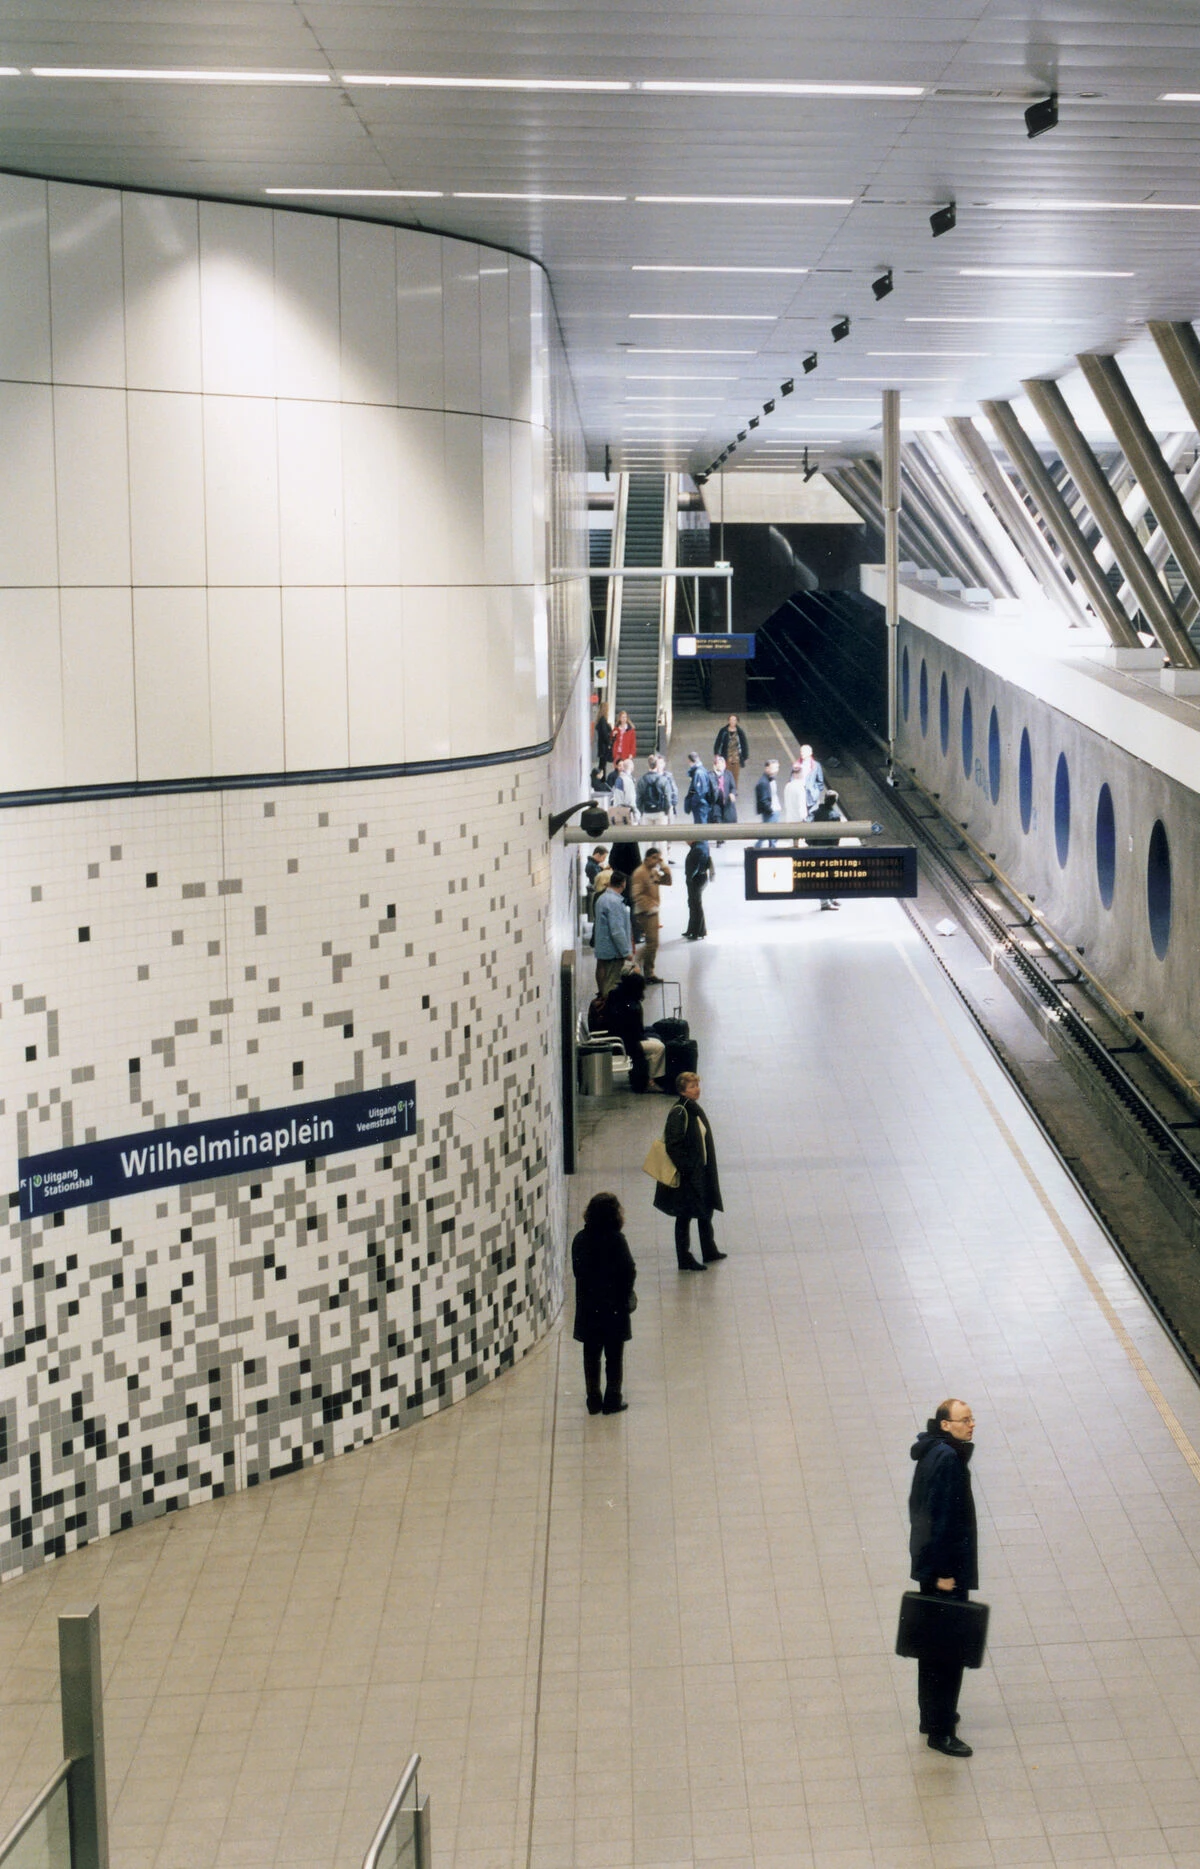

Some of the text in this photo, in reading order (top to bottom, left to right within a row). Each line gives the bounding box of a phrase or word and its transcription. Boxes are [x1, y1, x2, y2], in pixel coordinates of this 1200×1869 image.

[793, 859, 816, 867] Metro
[793, 870, 867, 878] Centraal Station
[368, 1105, 397, 1119] Uitgang
[356, 1115, 397, 1132] Veemstraat
[120, 1115, 335, 1179] Wilhelminaplein
[43, 1168, 79, 1184] Uitgang
[44, 1175, 93, 1197] Stationshal
